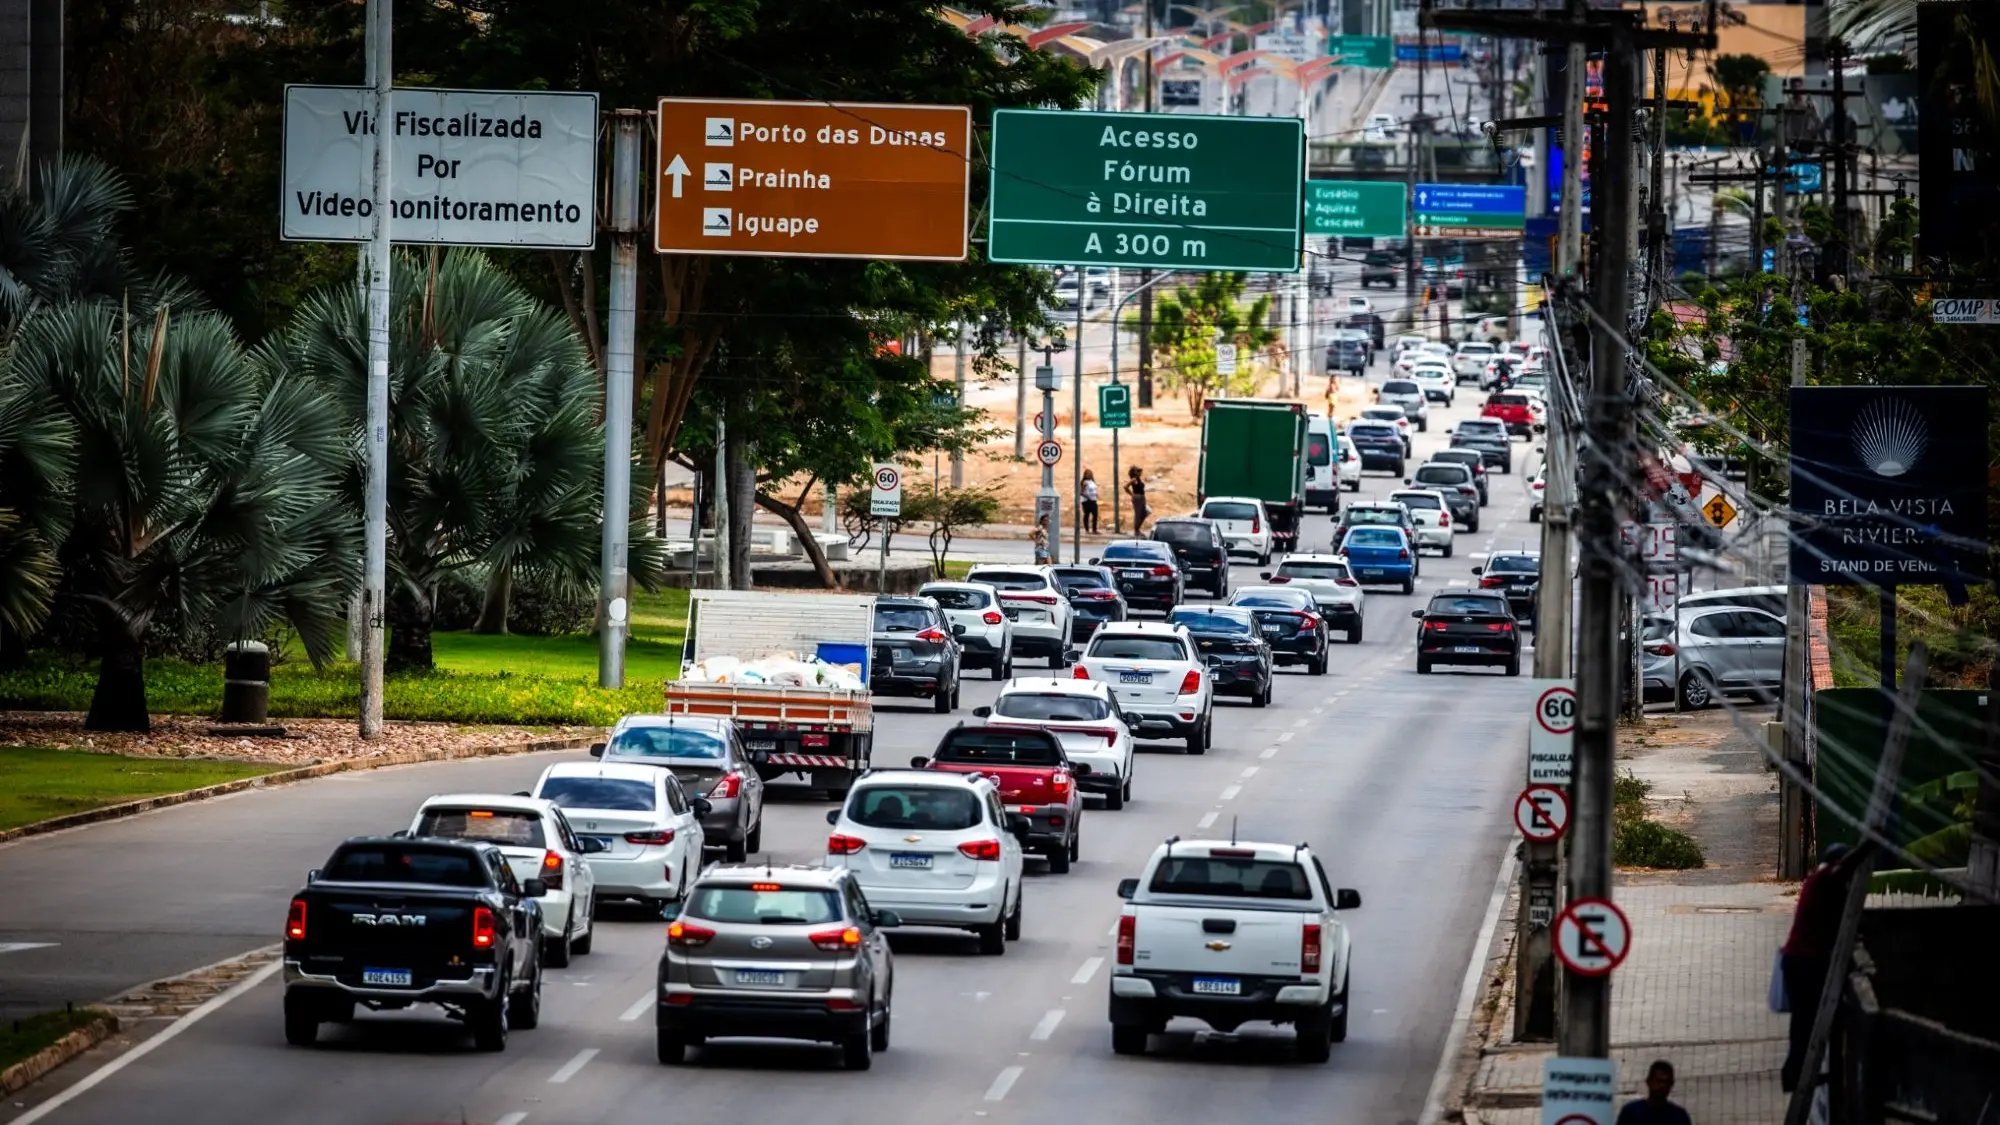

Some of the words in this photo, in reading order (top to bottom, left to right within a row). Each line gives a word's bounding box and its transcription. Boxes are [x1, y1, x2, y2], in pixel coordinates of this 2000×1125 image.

[396, 111, 542, 139] Fiscalizada
[740, 122, 807, 144] Porto
[816, 125, 860, 145] das
[869, 125, 946, 147] Dunas
[1100, 125, 1199, 150] Acesso
[417, 154, 461, 179] Por
[1103, 160, 1191, 184] Fórum
[738, 168, 832, 190] Prainha
[297, 191, 581, 223] Videoonitoramento
[1086, 191, 1101, 214] à
[1112, 192, 1208, 217] Direita
[737, 213, 820, 238] Iguape
[1315, 216, 1365, 229] Cascavel
[1084, 232, 1103, 254] A
[1115, 233, 1170, 256] 300
[1182, 238, 1207, 258] m
[1042, 446, 1059, 458] 60
[879, 472, 895, 483] 60
[1825, 499, 1880, 515] BELA
[1890, 499, 1955, 515] VISTA
[1843, 527, 1925, 545] RIVIER
[1820, 559, 1870, 573] STAND
[1875, 559, 1894, 573] DE
[1545, 699, 1575, 718] 60
[1531, 752, 1573, 763] FISCALIZA
[1531, 797, 1553, 829] E
[352, 913, 427, 927] RAM
[1578, 914, 1606, 958] E
